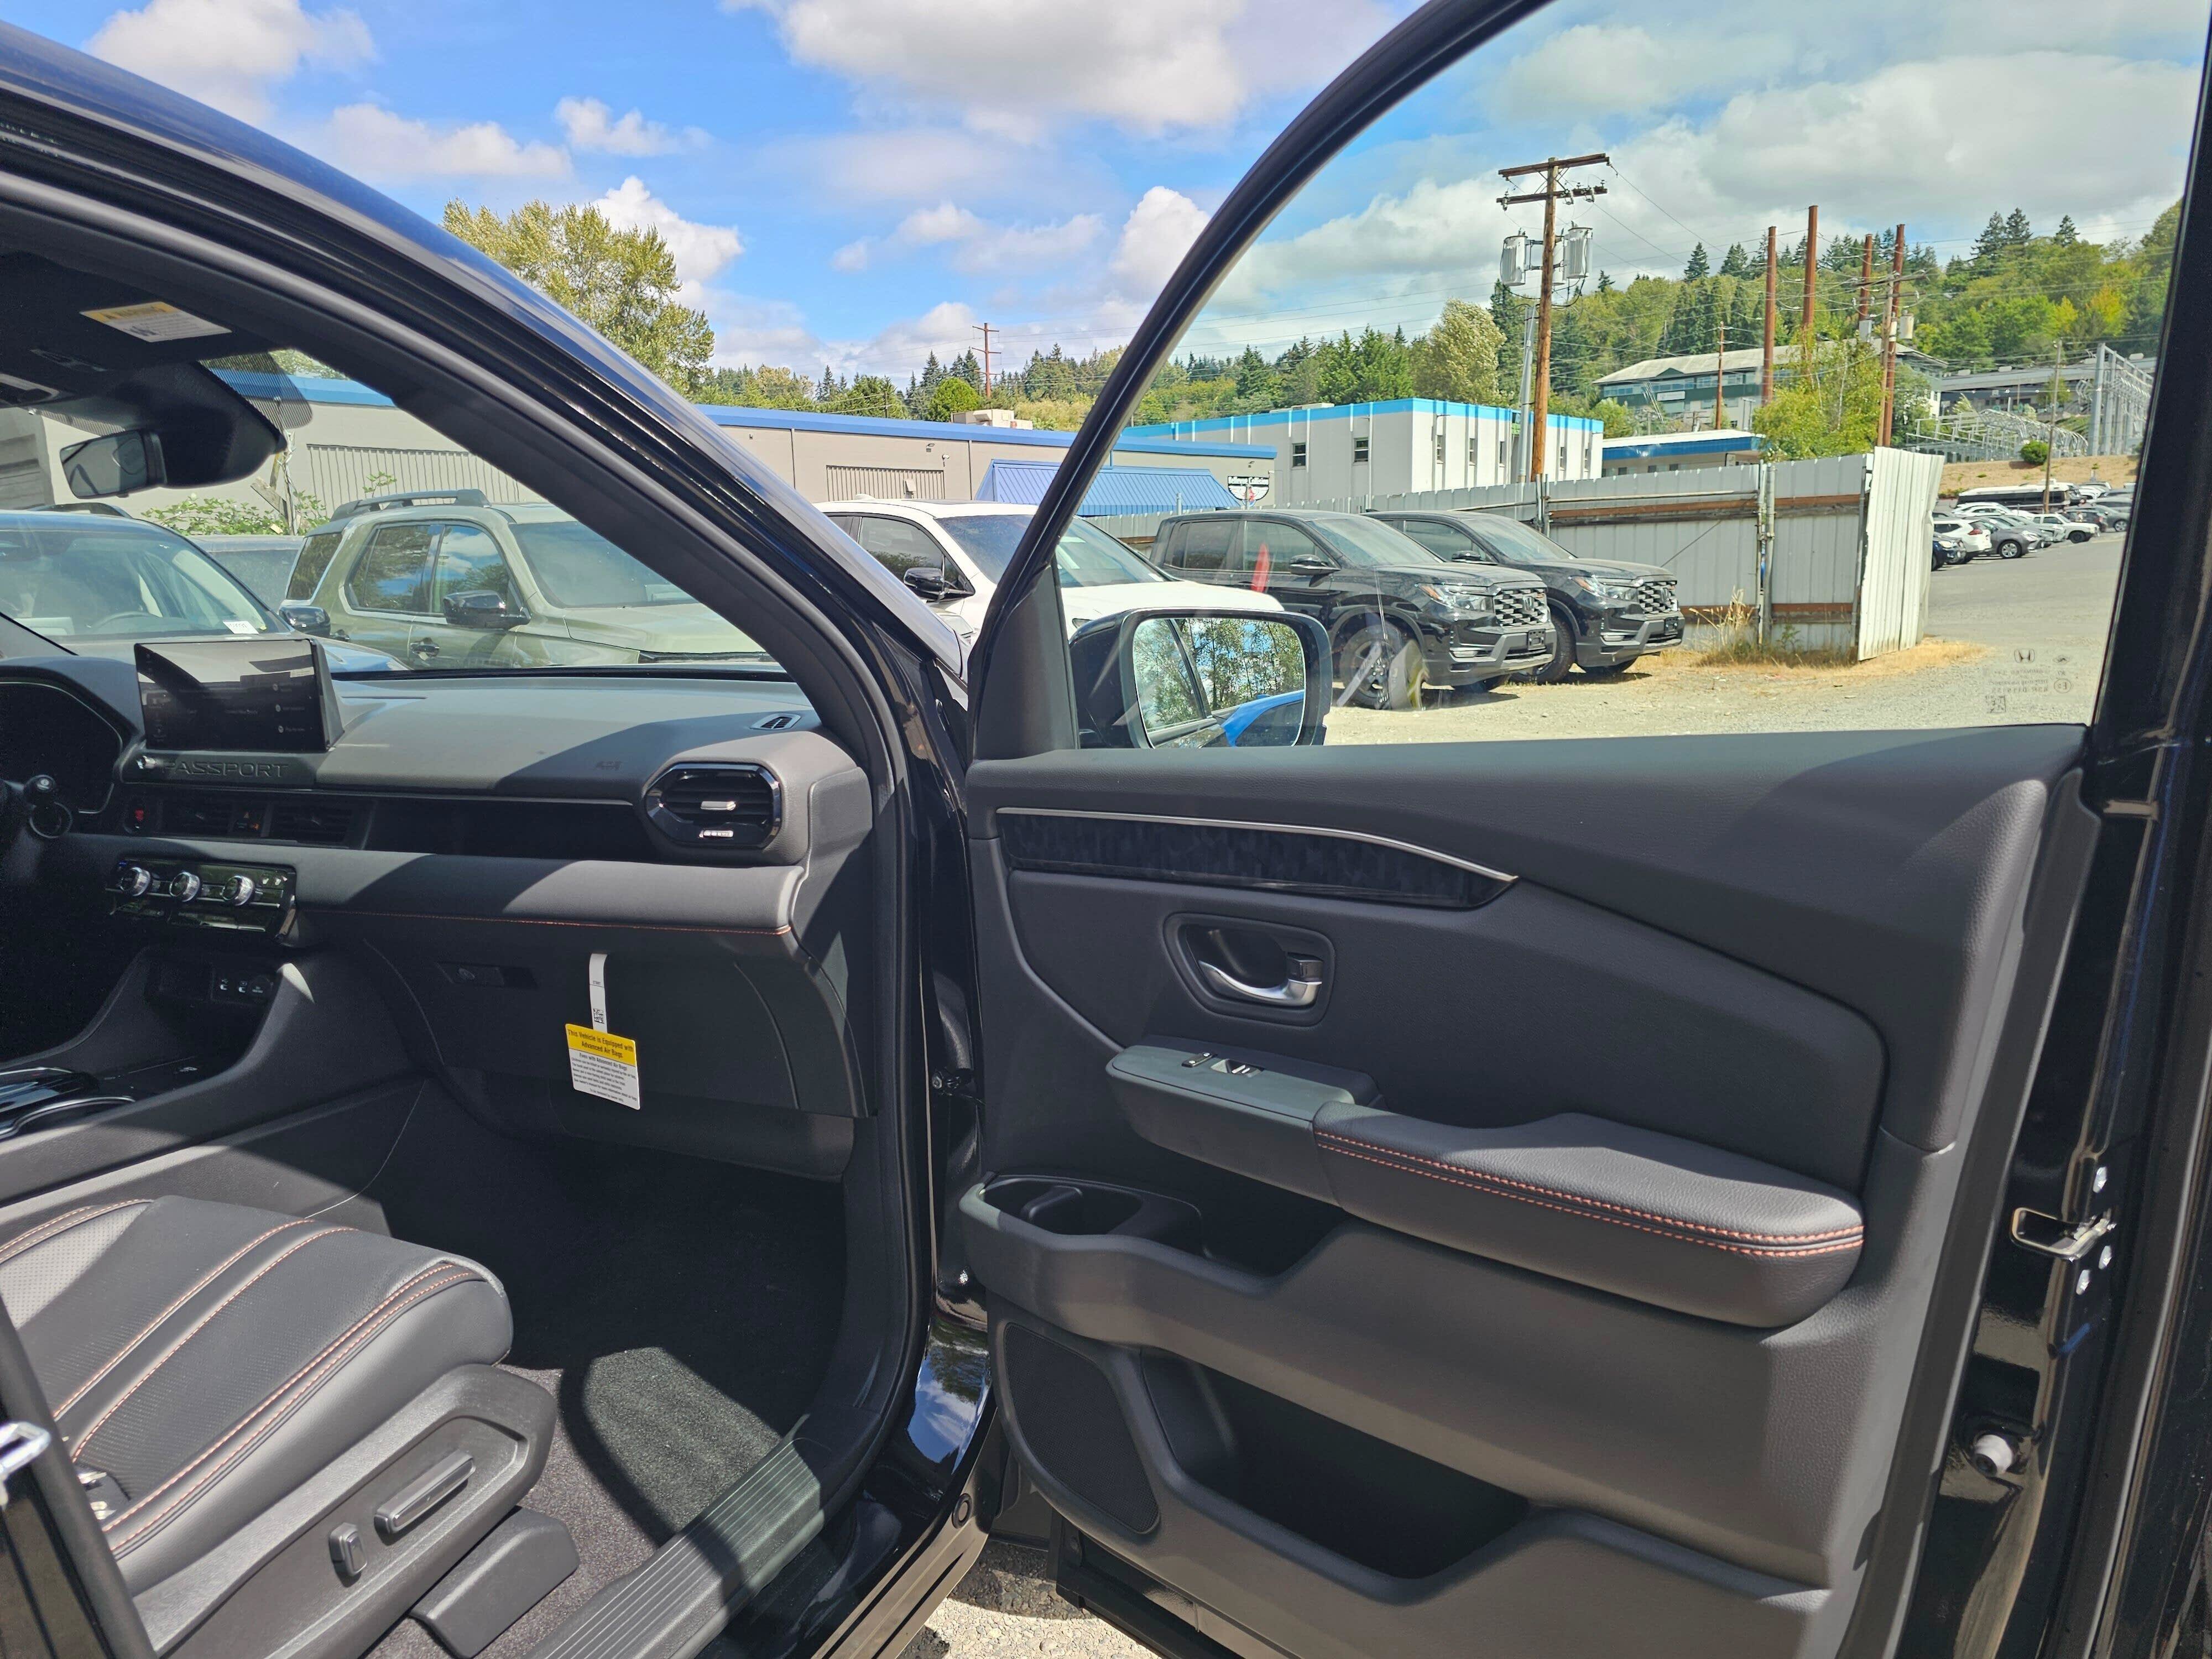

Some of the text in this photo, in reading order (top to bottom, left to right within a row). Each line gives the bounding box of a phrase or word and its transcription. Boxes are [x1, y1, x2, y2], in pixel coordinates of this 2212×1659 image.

[1228, 476, 1269, 485] Bellevue Collision
[163, 761, 289, 778] PASSPORT
[579, 1031, 596, 1041] Vehicle
[602, 1037, 623, 1049] Equipped
[582, 1041, 603, 1052] Advanced
[612, 1048, 623, 1058] Bags
[597, 1057, 613, 1066] Advanced
